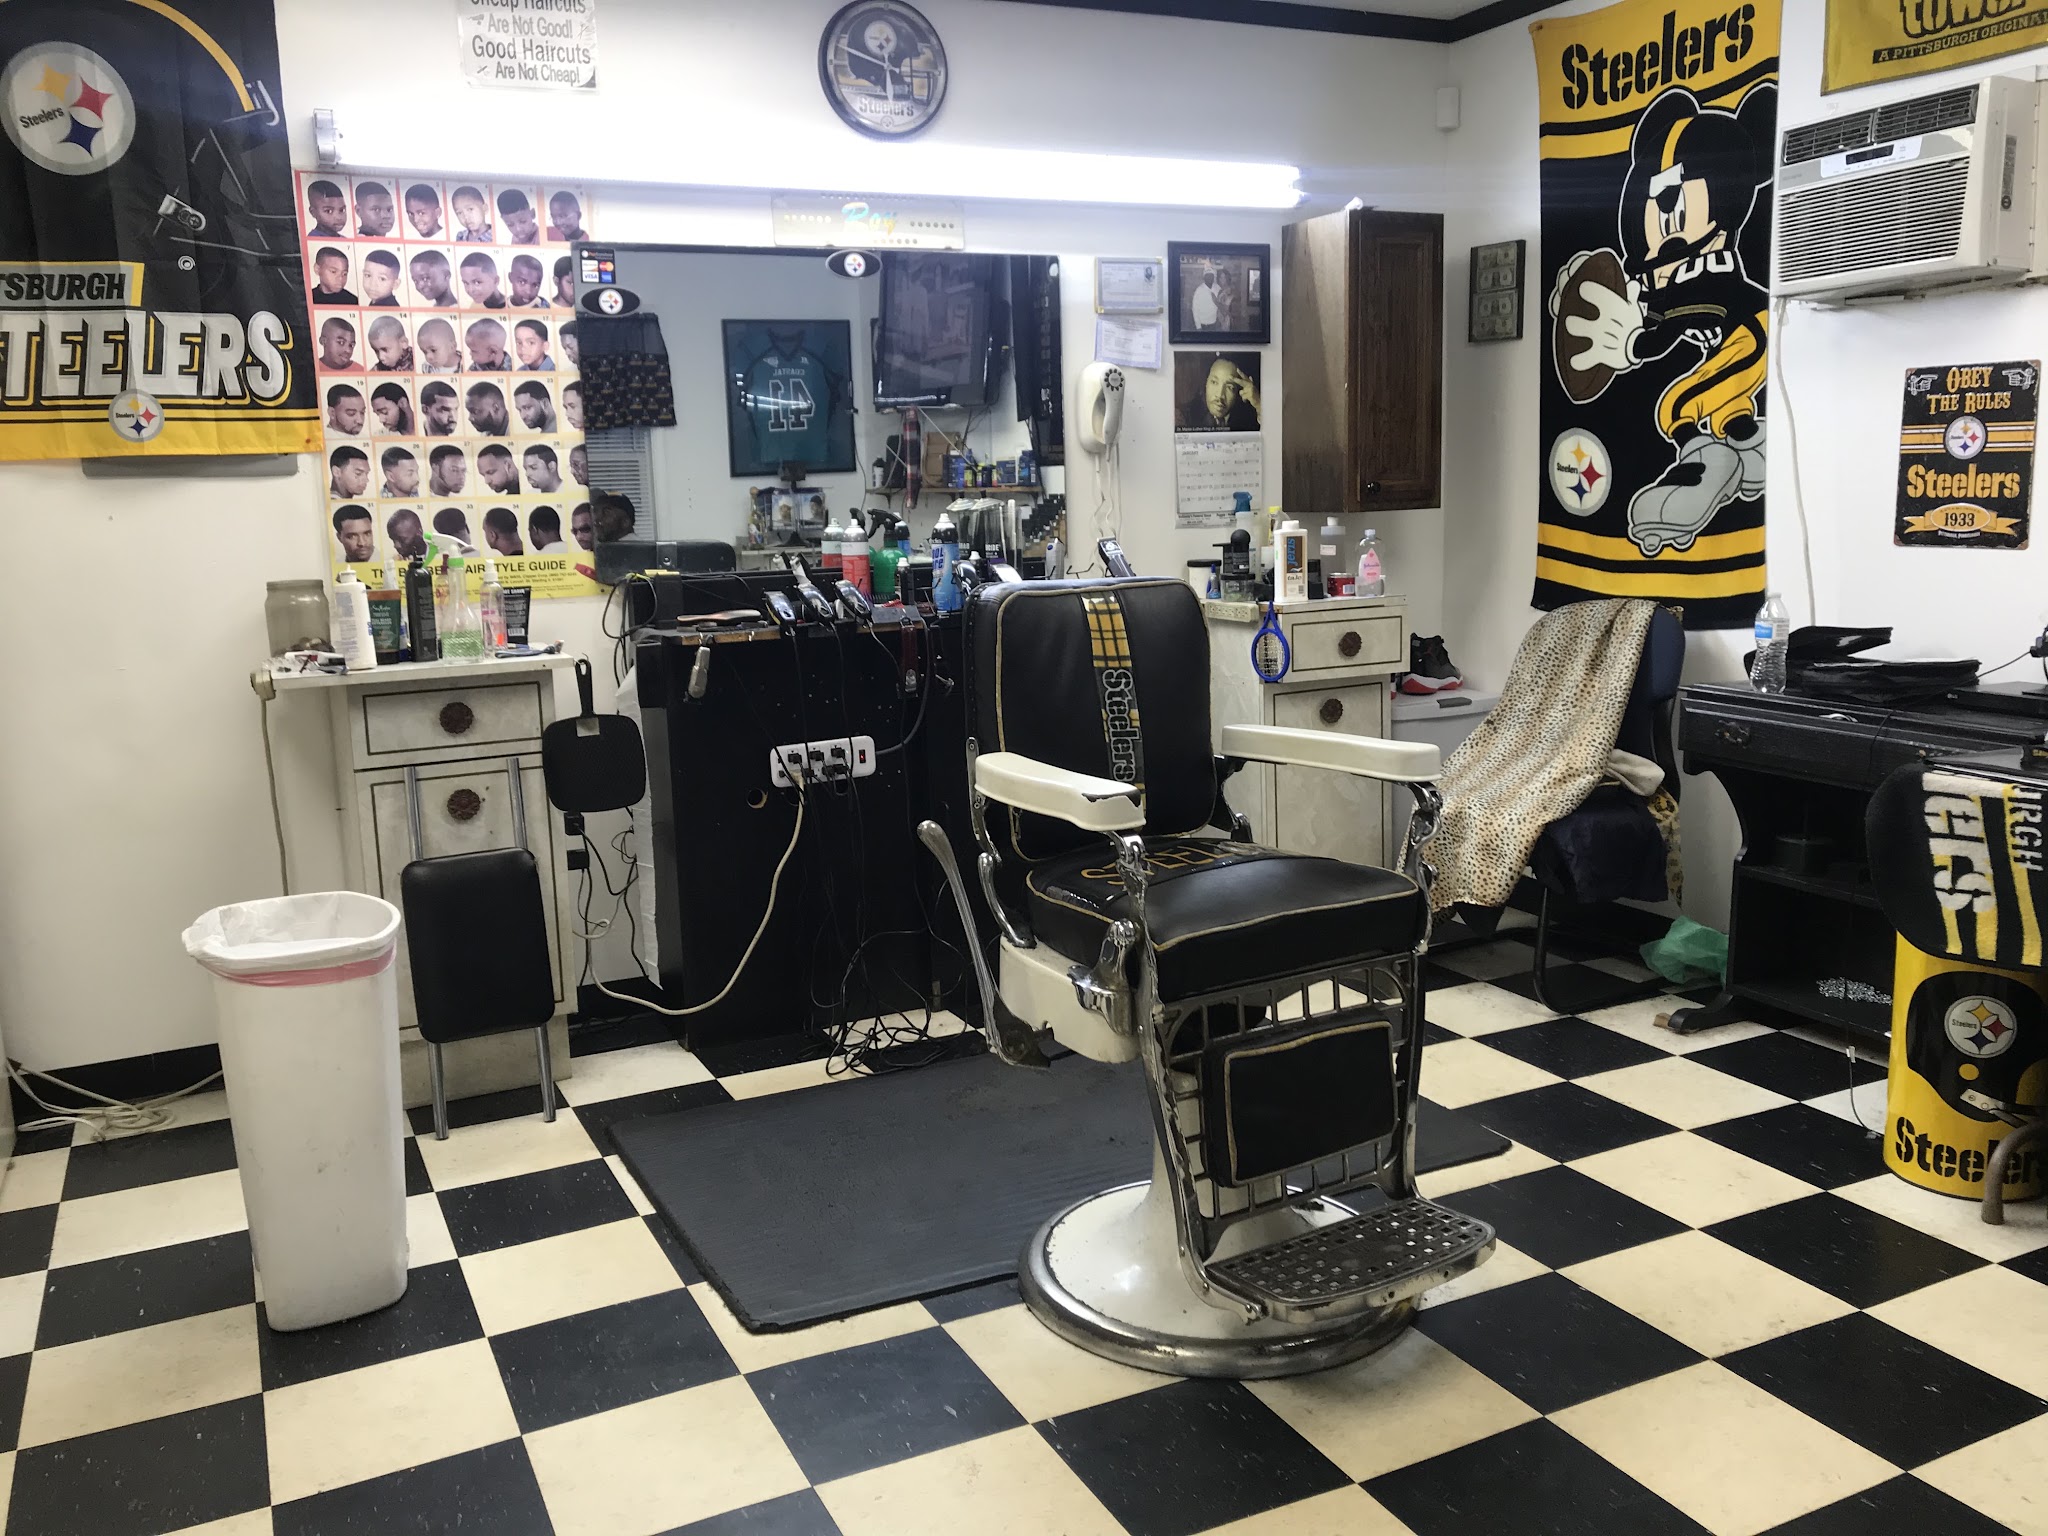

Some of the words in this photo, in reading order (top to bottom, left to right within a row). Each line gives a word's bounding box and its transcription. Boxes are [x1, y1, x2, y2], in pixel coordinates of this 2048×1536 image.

[488, 13, 509, 34] Are
[512, 14, 534, 36] Not
[537, 17, 573, 39] Good!
[472, 35, 516, 60] Good
[522, 38, 591, 64] Haircuts
[1562, 4, 1755, 109] Steelers
[1879, 51, 1890, 62] A
[1893, 30, 1979, 60] PITTSBURGH
[495, 61, 515, 80] Are
[518, 62, 538, 81] Not
[541, 64, 580, 87] Cheap!
[19, 105, 65, 130] Steelers
[858, 96, 914, 117] Steelers
[0, 311, 290, 400] TEELERS
[1946, 366, 1993, 392] OBEY
[1927, 393, 1959, 414] THE
[1964, 391, 2011, 413] RULES
[1557, 463, 1578, 474] Steelers
[1907, 463, 2020, 498] Steelers
[1944, 512, 1975, 527] 1933
[529, 560, 567, 571] GUIDE
[1102, 669, 1140, 782] Steelers
[1951, 1018, 1977, 1029] Steelers
